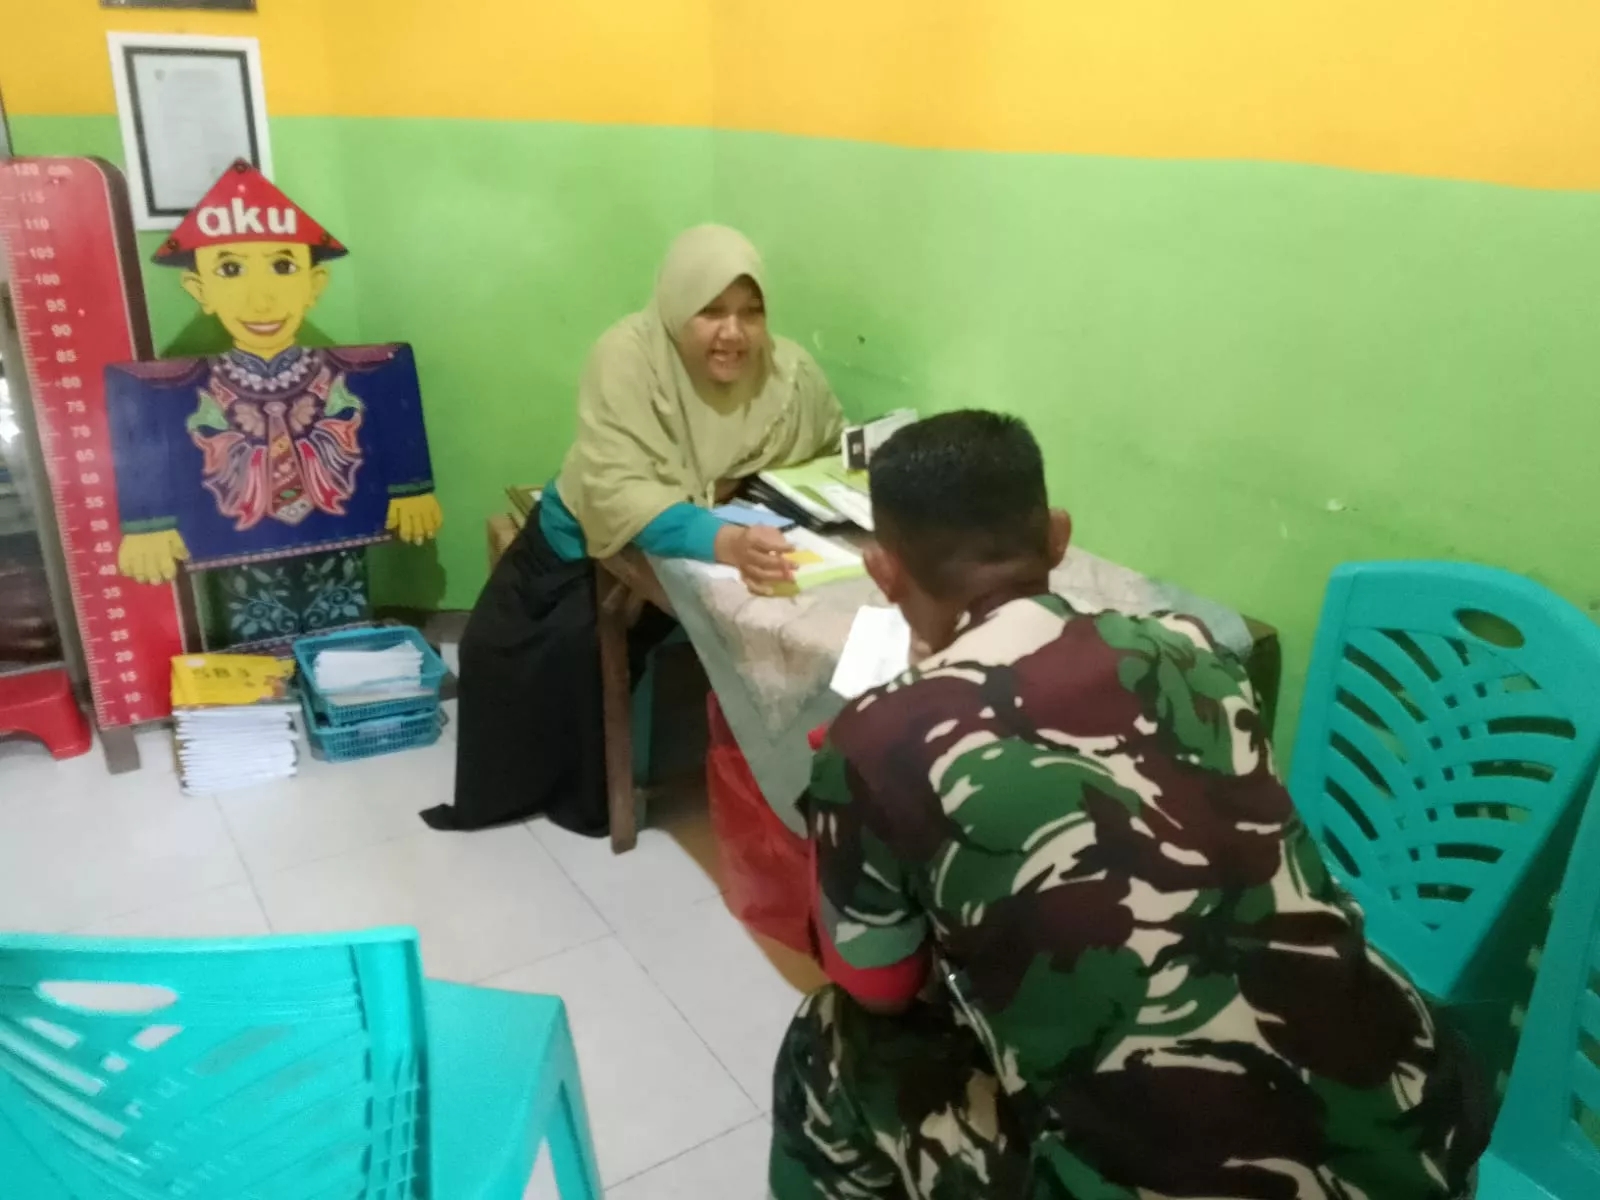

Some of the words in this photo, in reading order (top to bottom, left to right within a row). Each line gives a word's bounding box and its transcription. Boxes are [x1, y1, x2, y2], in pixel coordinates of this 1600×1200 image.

[13, 162, 40, 177] 120
[196, 197, 297, 237] aku
[24, 217, 50, 231] 110
[29, 246, 55, 260] 105
[35, 273, 61, 287] 100
[45, 298, 67, 313] 95
[51, 323, 73, 338] 90
[56, 349, 77, 363] 85
[61, 376, 82, 389] 80
[66, 400, 86, 413] 75
[70, 425, 92, 438] 70
[76, 449, 95, 463] 65
[81, 473, 100, 485] 60
[85, 496, 105, 509] 55
[90, 519, 109, 532] 50
[94, 541, 113, 554] 45
[99, 564, 117, 577] 40
[103, 587, 121, 600] 35
[106, 607, 125, 620] 30
[110, 629, 129, 642] 25
[115, 651, 134, 664] 20
[120, 671, 138, 683] 15
[124, 692, 141, 704] 10
